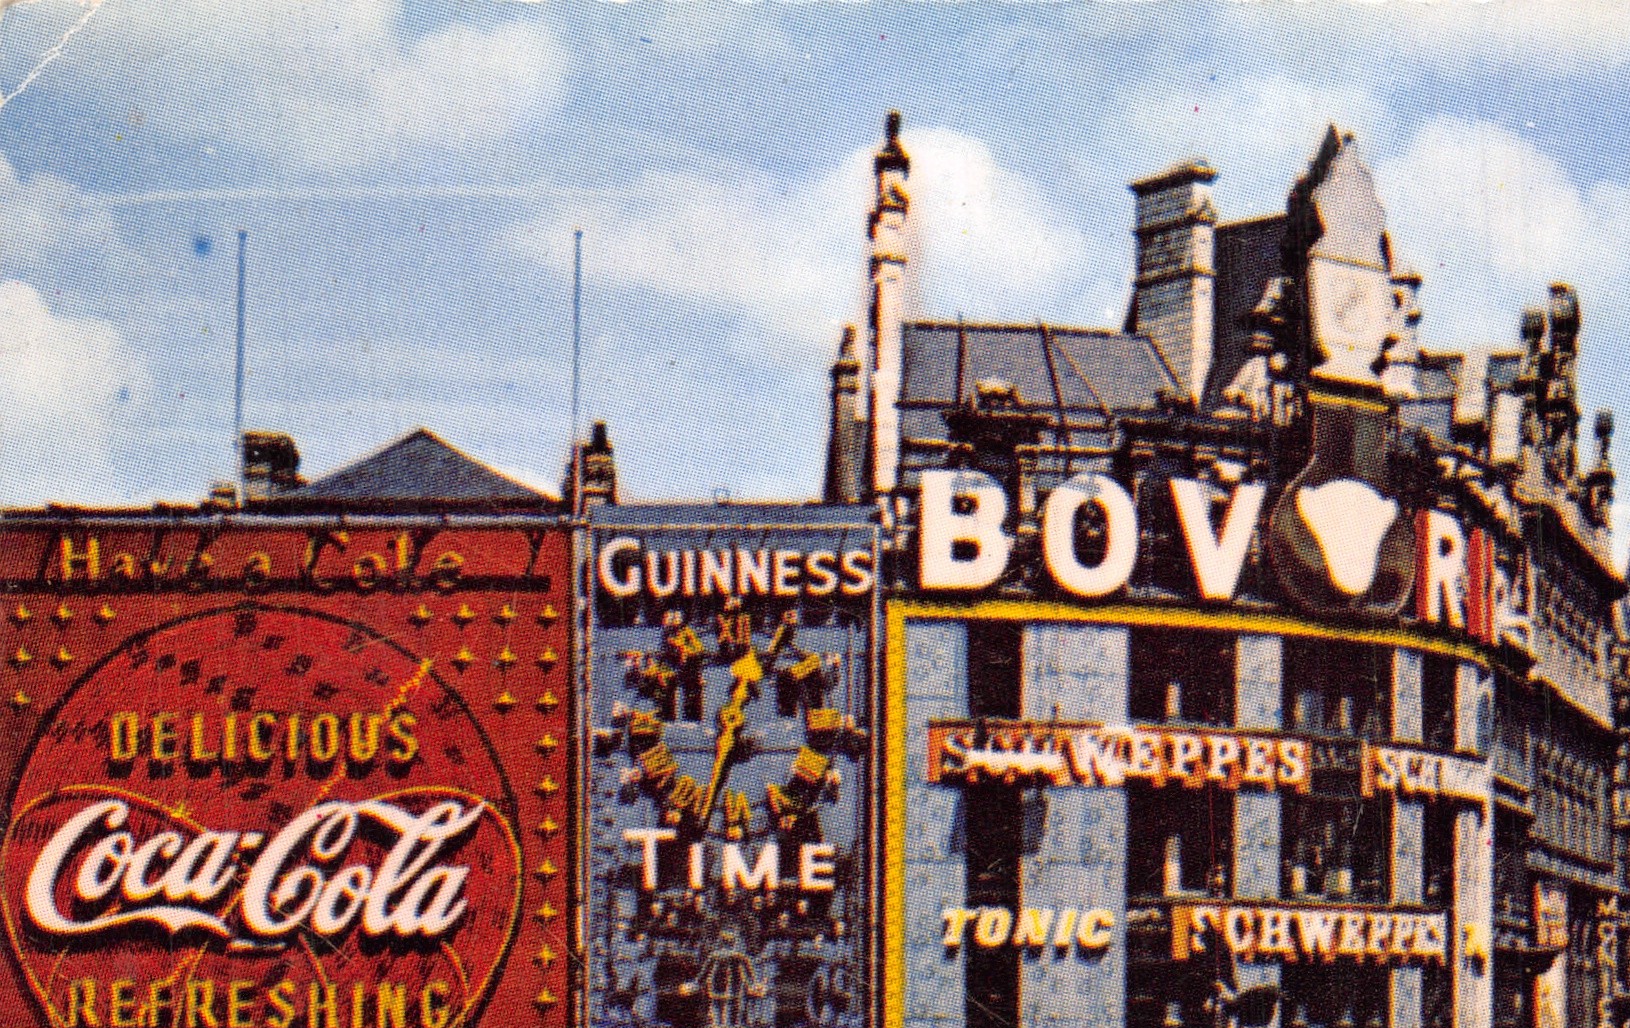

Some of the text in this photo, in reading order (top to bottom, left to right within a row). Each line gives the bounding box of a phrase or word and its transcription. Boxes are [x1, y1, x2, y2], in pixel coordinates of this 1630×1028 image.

[599, 535, 873, 597] GUINNESS
[110, 711, 420, 764] DELICIOUS
[26, 799, 487, 938] Coca-Cola
[623, 827, 837, 893] TIME
[940, 907, 1115, 949] TONIC
